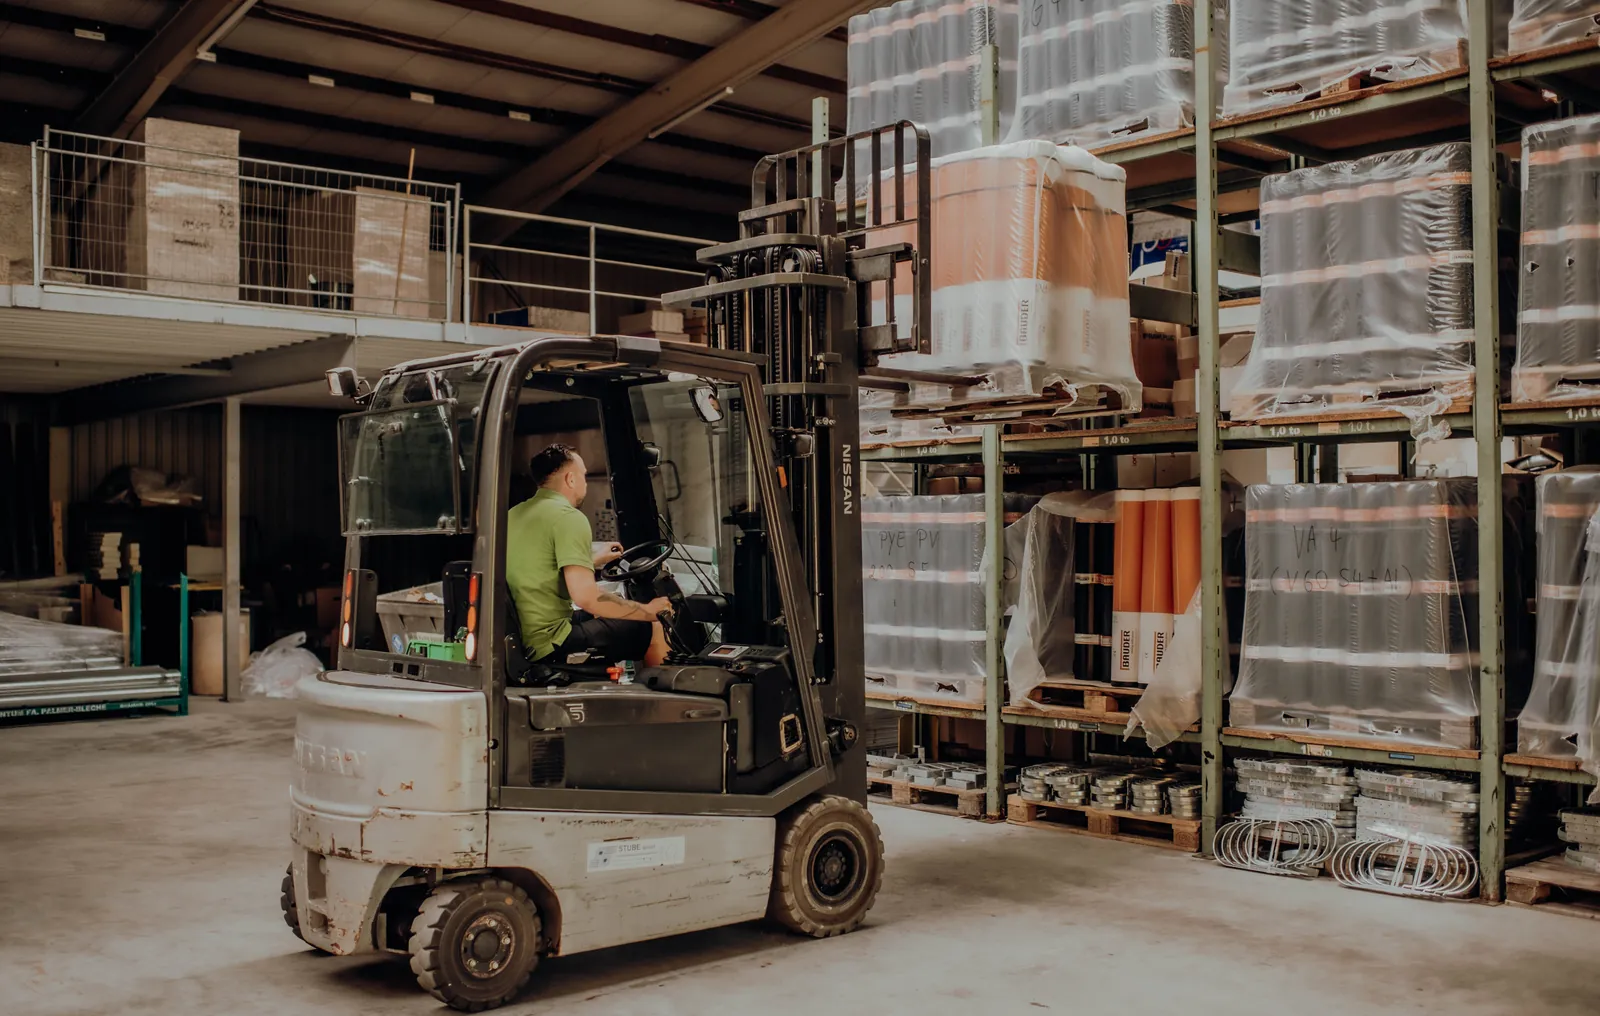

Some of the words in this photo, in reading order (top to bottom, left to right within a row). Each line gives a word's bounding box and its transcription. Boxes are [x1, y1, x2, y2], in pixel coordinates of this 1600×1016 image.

[1104, 436, 1118, 445] 1,0
[1269, 426, 1287, 437] 1,0
[1288, 426, 1301, 435] to
[842, 444, 853, 515] NISSAN
[1293, 525, 1317, 559] VA
[1330, 526, 1342, 553] 4
[1122, 630, 1130, 668] BAUDER
[1156, 631, 1164, 669] AUDER
